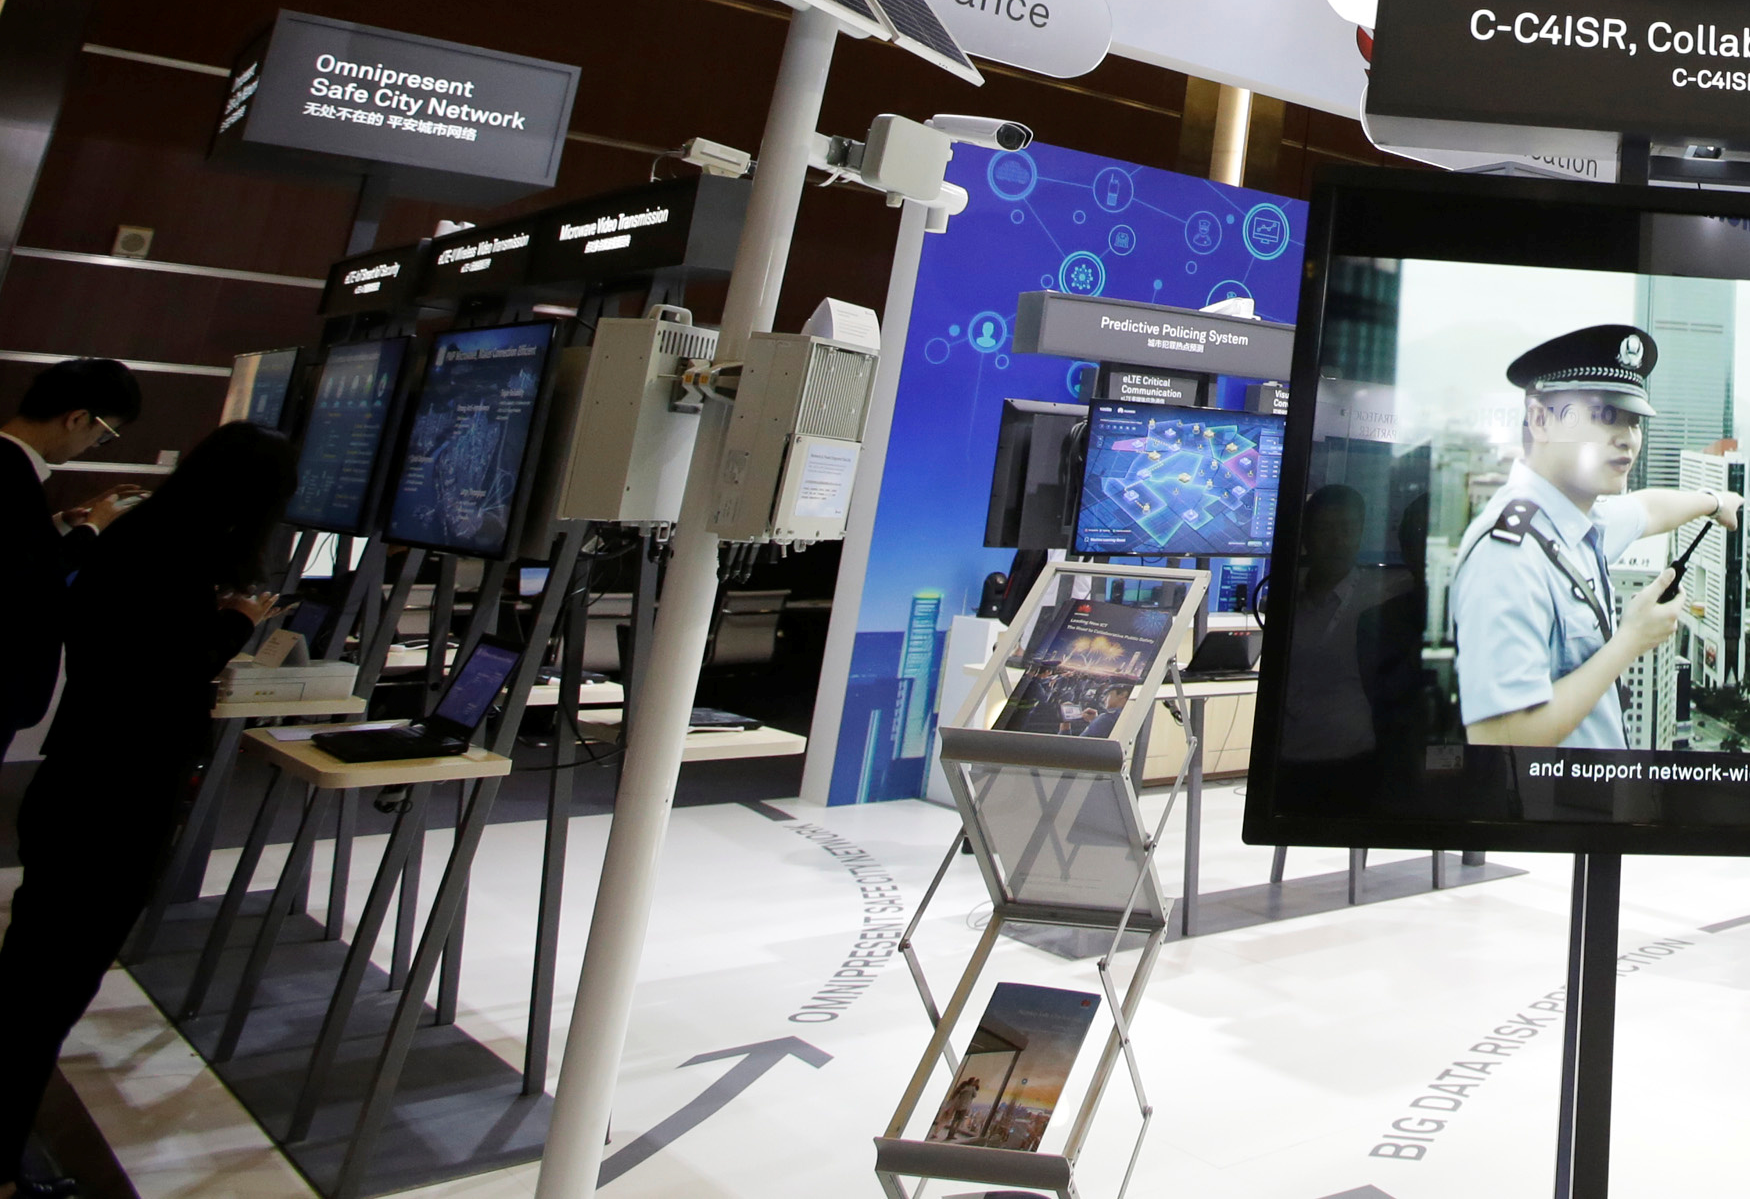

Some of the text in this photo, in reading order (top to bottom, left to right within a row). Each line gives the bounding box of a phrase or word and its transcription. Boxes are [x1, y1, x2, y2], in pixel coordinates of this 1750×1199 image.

[1470, 8, 1637, 56] C-C4ISR,
[315, 53, 474, 98] Omnipresent
[309, 78, 526, 130] Safe City Network
[303, 102, 477, 142] 无处不在的 平安城市网络
[618, 205, 669, 230] Transmission
[1100, 316, 1249, 346] Predictive Policing System
[1121, 385, 1182, 399] Communication
[1122, 374, 1171, 387] eLTE Critical
[1529, 758, 1564, 778] and
[1571, 761, 1643, 782] support
[844, 863, 894, 884] CITY
[860, 885, 904, 914] SAFE
[788, 916, 904, 1023] OMNIPRESENT
[1368, 1117, 1449, 1161] BIG
[1409, 1061, 1502, 1113] DATA
[1468, 1013, 1557, 1056] RISK
